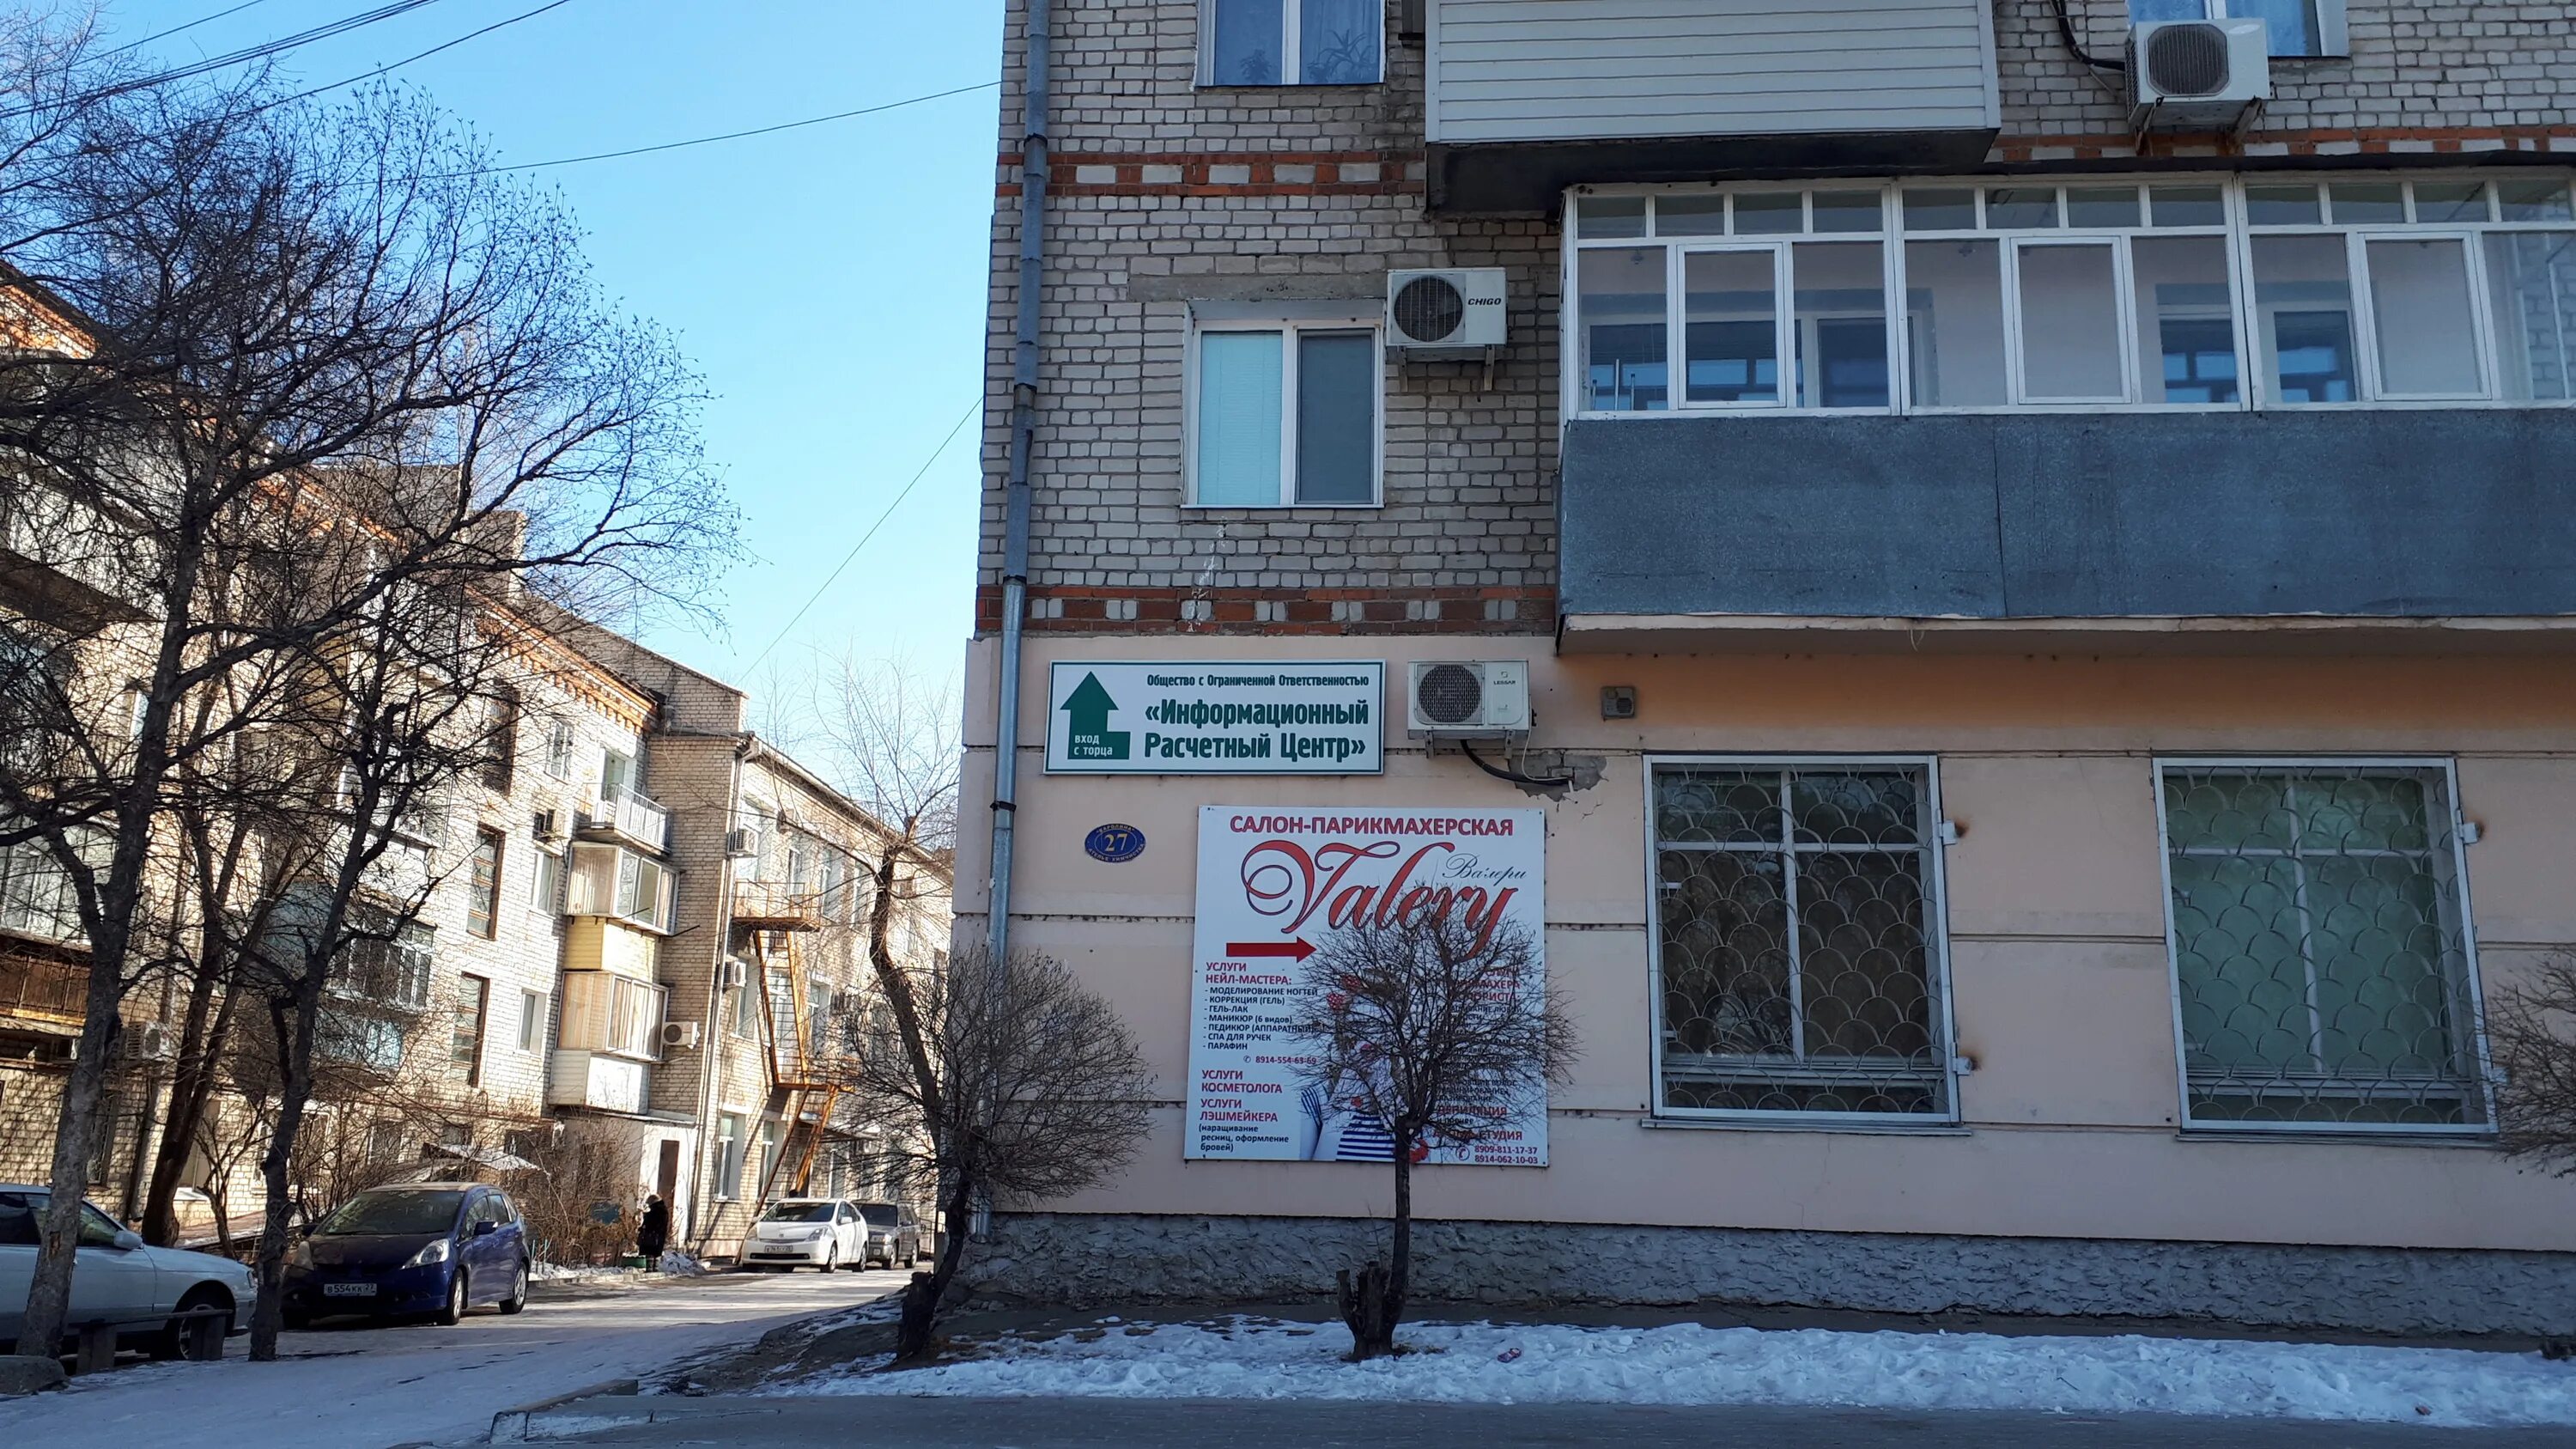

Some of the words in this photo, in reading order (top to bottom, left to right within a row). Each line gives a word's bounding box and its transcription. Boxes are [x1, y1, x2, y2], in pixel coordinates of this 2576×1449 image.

[1467, 297, 1502, 306] CHIGO
[1146, 674, 1195, 688] Общество
[1198, 677, 1204, 686] с
[1206, 674, 1275, 688] Ограниченной
[1279, 674, 1370, 686] Ответственностью
[1145, 698, 1369, 729] «Информационный
[1073, 746, 1080, 756] с
[1083, 746, 1113, 758] торца
[1144, 732, 1271, 758] Расчетный
[1280, 733, 1366, 763] Центр»
[1230, 815, 1514, 837] САЛОН-ПАРИКМАХЕРСКАЯ
[1104, 833, 1128, 852] 27
[1241, 840, 1519, 960] Valery
[1206, 962, 1247, 972] УСЛУГИ
[1206, 972, 1292, 985] НЕЙЛ-МАСТЕРА:
[1209, 987, 1285, 995] МОДЕЛИРОВАНИЕ
[1209, 996, 1258, 1005] КОРРЕКЦИЯ
[1260, 996, 1285, 1005] (ГЕЛЬ)
[1265, 1015, 1292, 1024] видов)
[1226, 1033, 1243, 1042] ДЛЯ
[1207, 1042, 1248, 1050] ПАРАФИН
[1201, 1069, 1243, 1081] УСЛУГИ
[1201, 1082, 1283, 1093] КОСМЕТОЛОГА
[1200, 1099, 1242, 1109] УСЛУГИ
[1200, 1110, 1279, 1122] ЛЭШМЕЙКЕРА
[1199, 1123, 1259, 1133] (наращивание
[1200, 1135, 1234, 1143] ресниц,
[1236, 1135, 1289, 1143] оформление
[1200, 1143, 1234, 1153] бровей)
[1474, 1145, 1538, 1154] 8909-811-17-37
[1474, 1154, 1539, 1165] 8914-062-10-03
